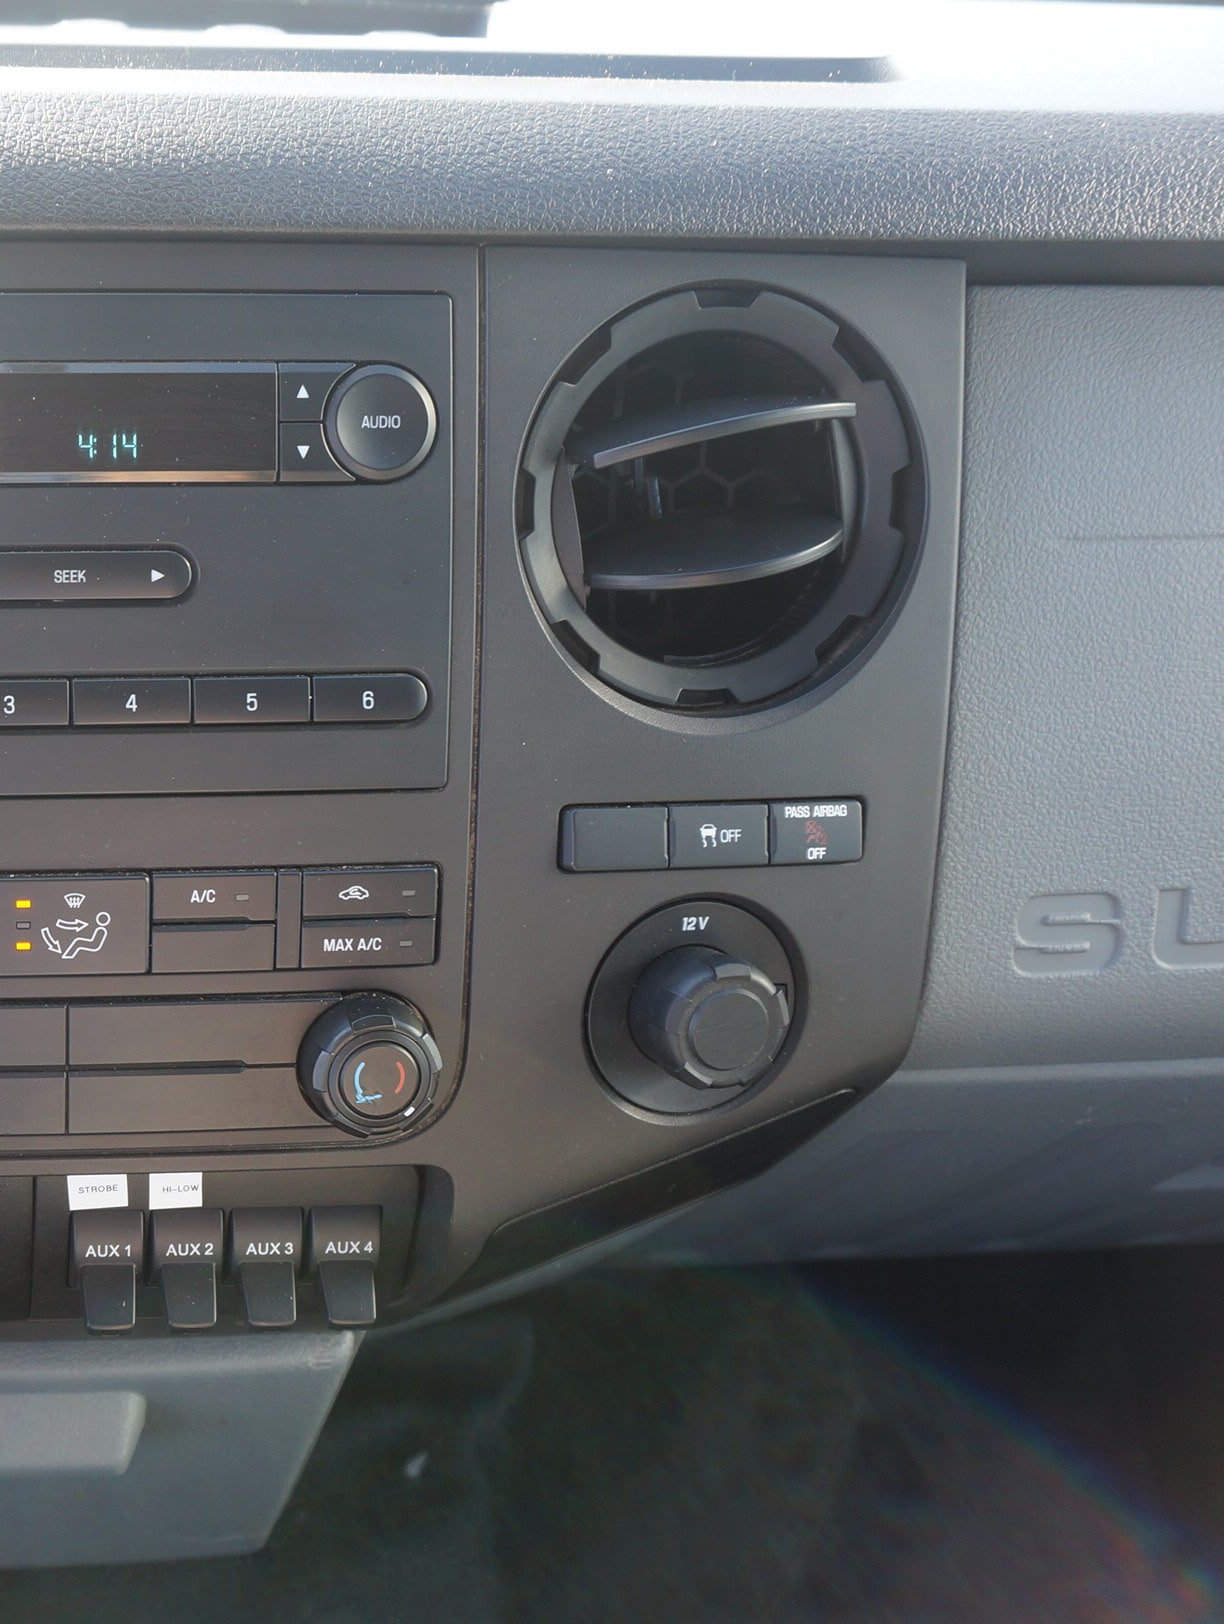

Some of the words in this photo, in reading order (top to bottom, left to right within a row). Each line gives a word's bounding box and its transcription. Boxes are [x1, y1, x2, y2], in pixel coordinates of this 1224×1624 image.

[360, 414, 401, 429] AUDIO
[78, 433, 137, 459] 4:14
[53, 569, 87, 584] SEEK
[3, 695, 16, 715] 3
[125, 693, 138, 713] 4
[246, 692, 258, 712] 5
[362, 690, 375, 710] 6
[784, 805, 811, 819] PASS
[812, 804, 848, 818] AIRBAG
[719, 828, 742, 843] OFF
[807, 846, 827, 860] OFF
[190, 889, 216, 903] A/C
[323, 938, 354, 952] MAX
[356, 937, 382, 951] A/C
[78, 1183, 119, 1194] STROBE
[162, 1184, 200, 1193] HI-LOW
[85, 1244, 120, 1258] AUX
[124, 1244, 131, 1257] 1
[165, 1242, 201, 1257] AUX
[204, 1242, 214, 1256] 2
[245, 1242, 281, 1256] AUX
[284, 1242, 294, 1255] 3
[324, 1241, 361, 1254] AUX
[363, 1240, 374, 1254] 4
